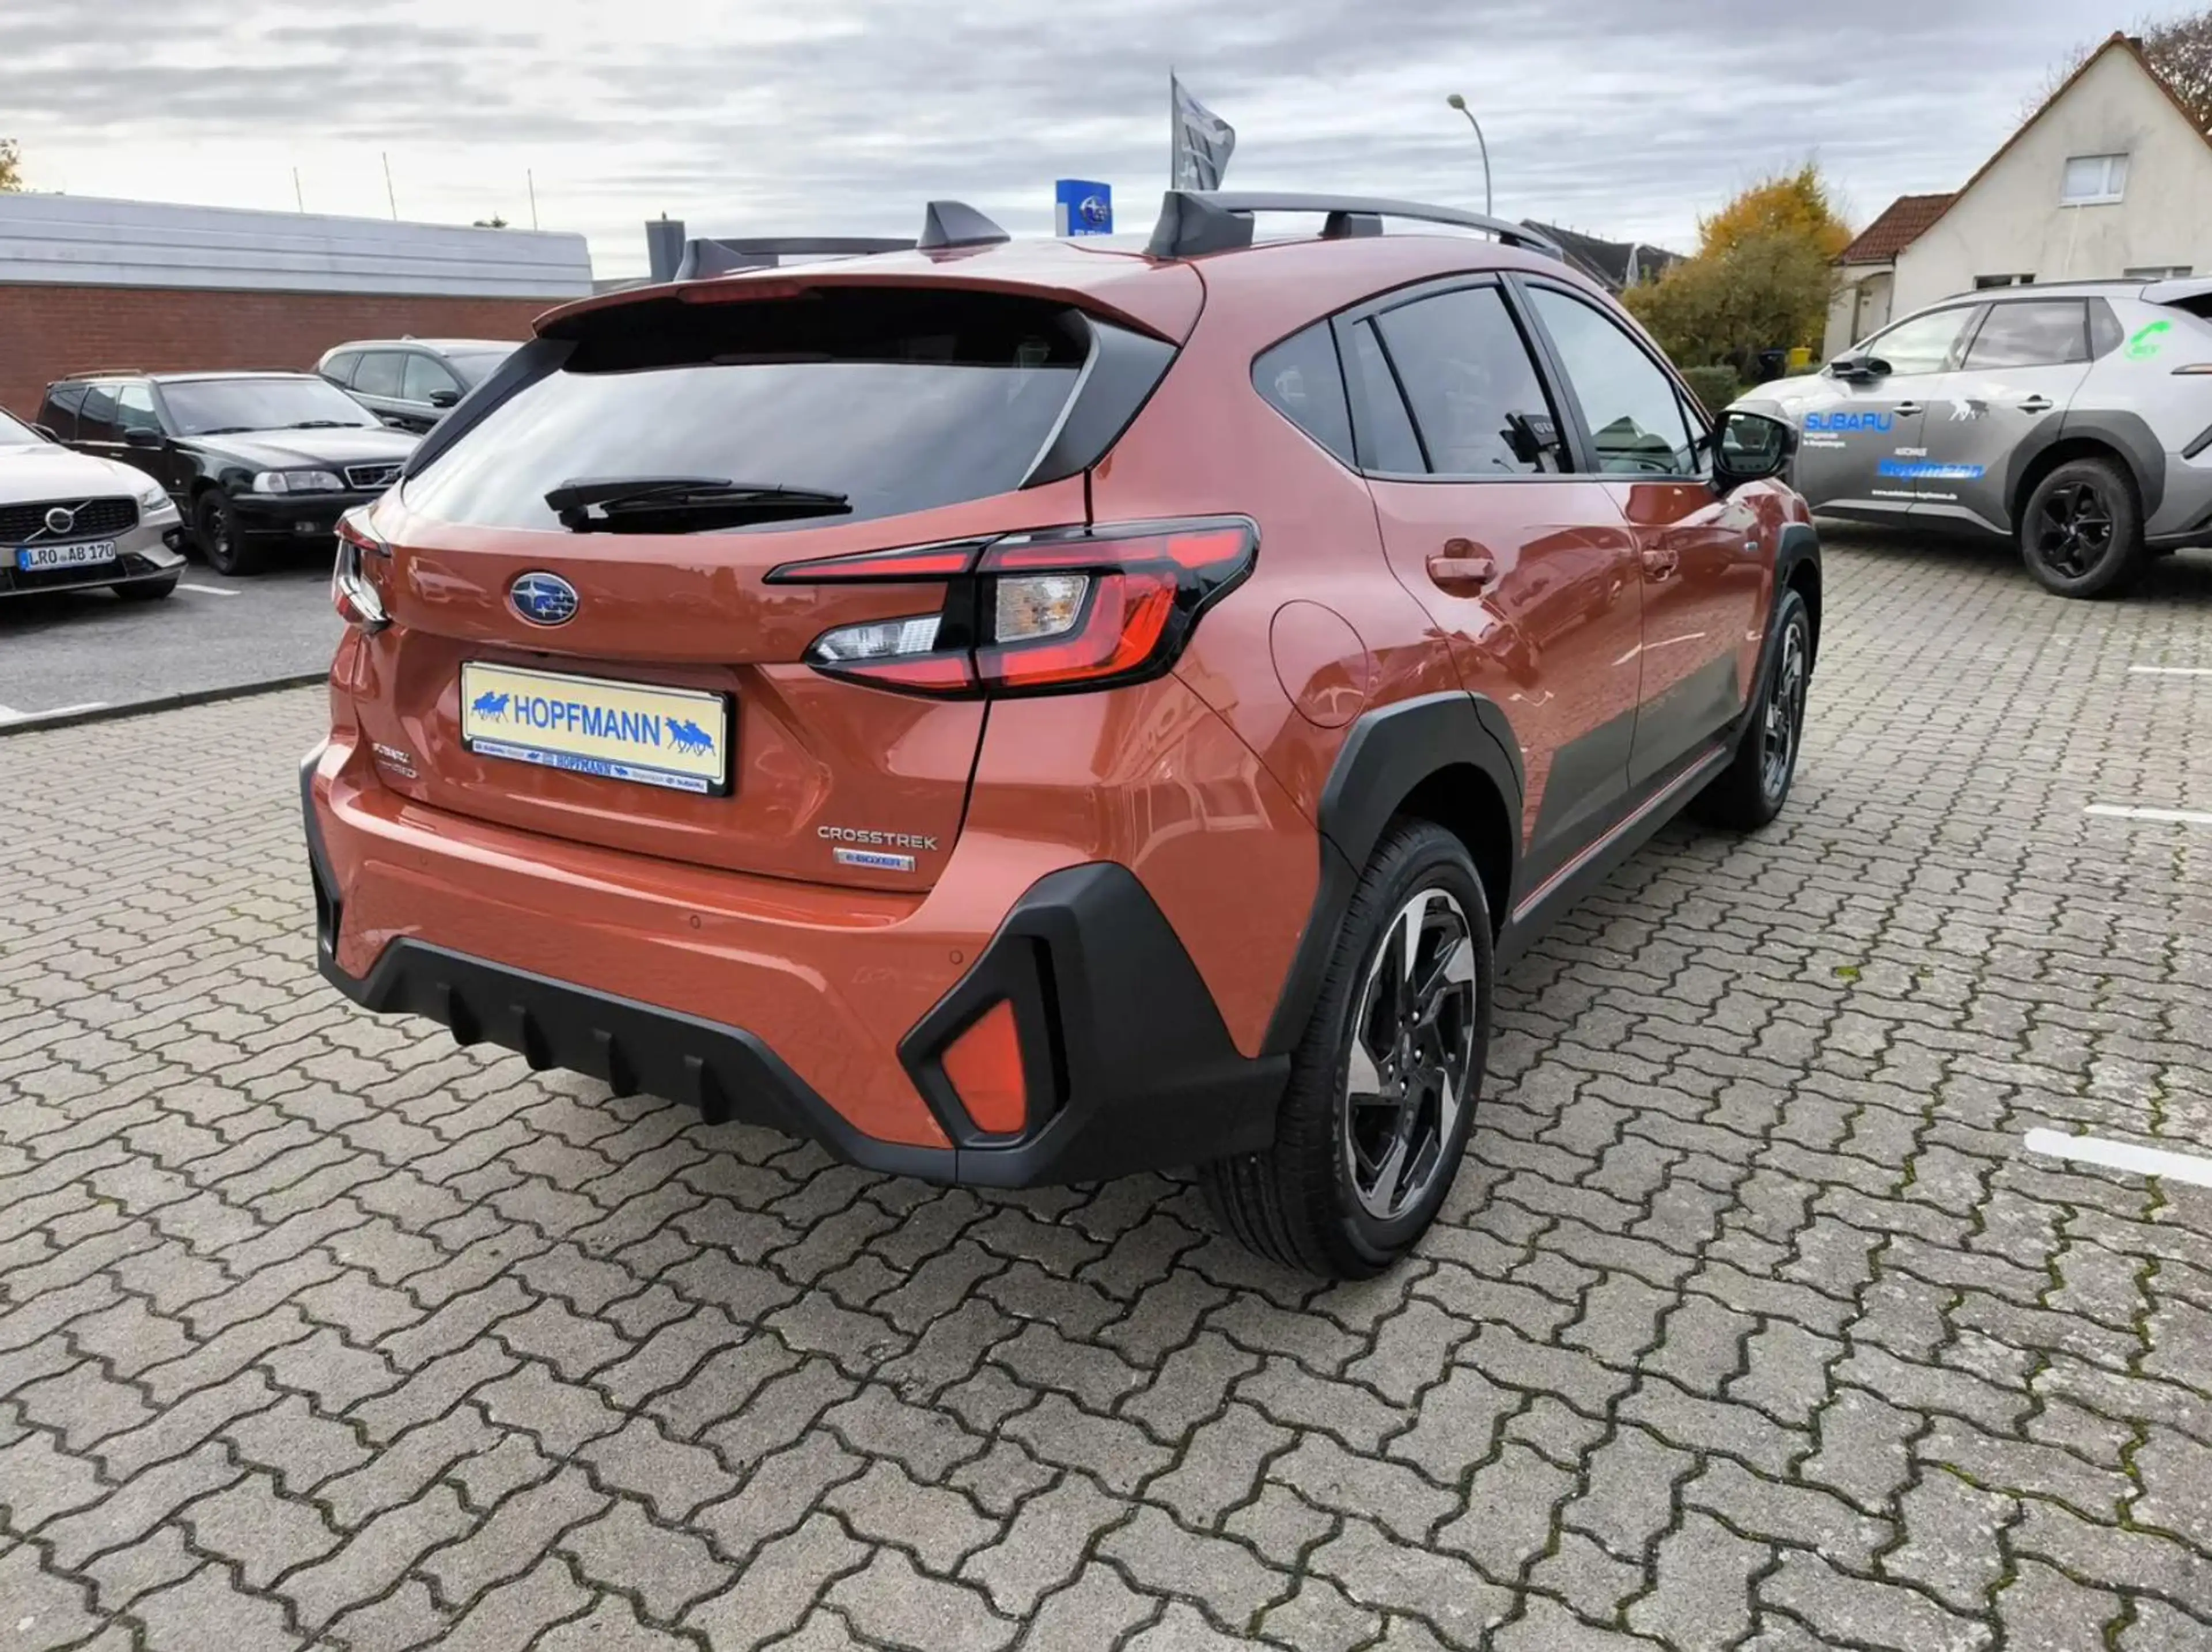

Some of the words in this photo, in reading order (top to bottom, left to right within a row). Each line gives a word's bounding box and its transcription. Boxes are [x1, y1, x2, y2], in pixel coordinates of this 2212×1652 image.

[1805, 412, 1892, 432] SUBARU
[29, 550, 57, 565] LRO
[69, 547, 86, 562] AB
[89, 544, 114, 560] 170
[513, 694, 661, 746] HOPFMANN
[817, 825, 938, 850] CROSSTREK
